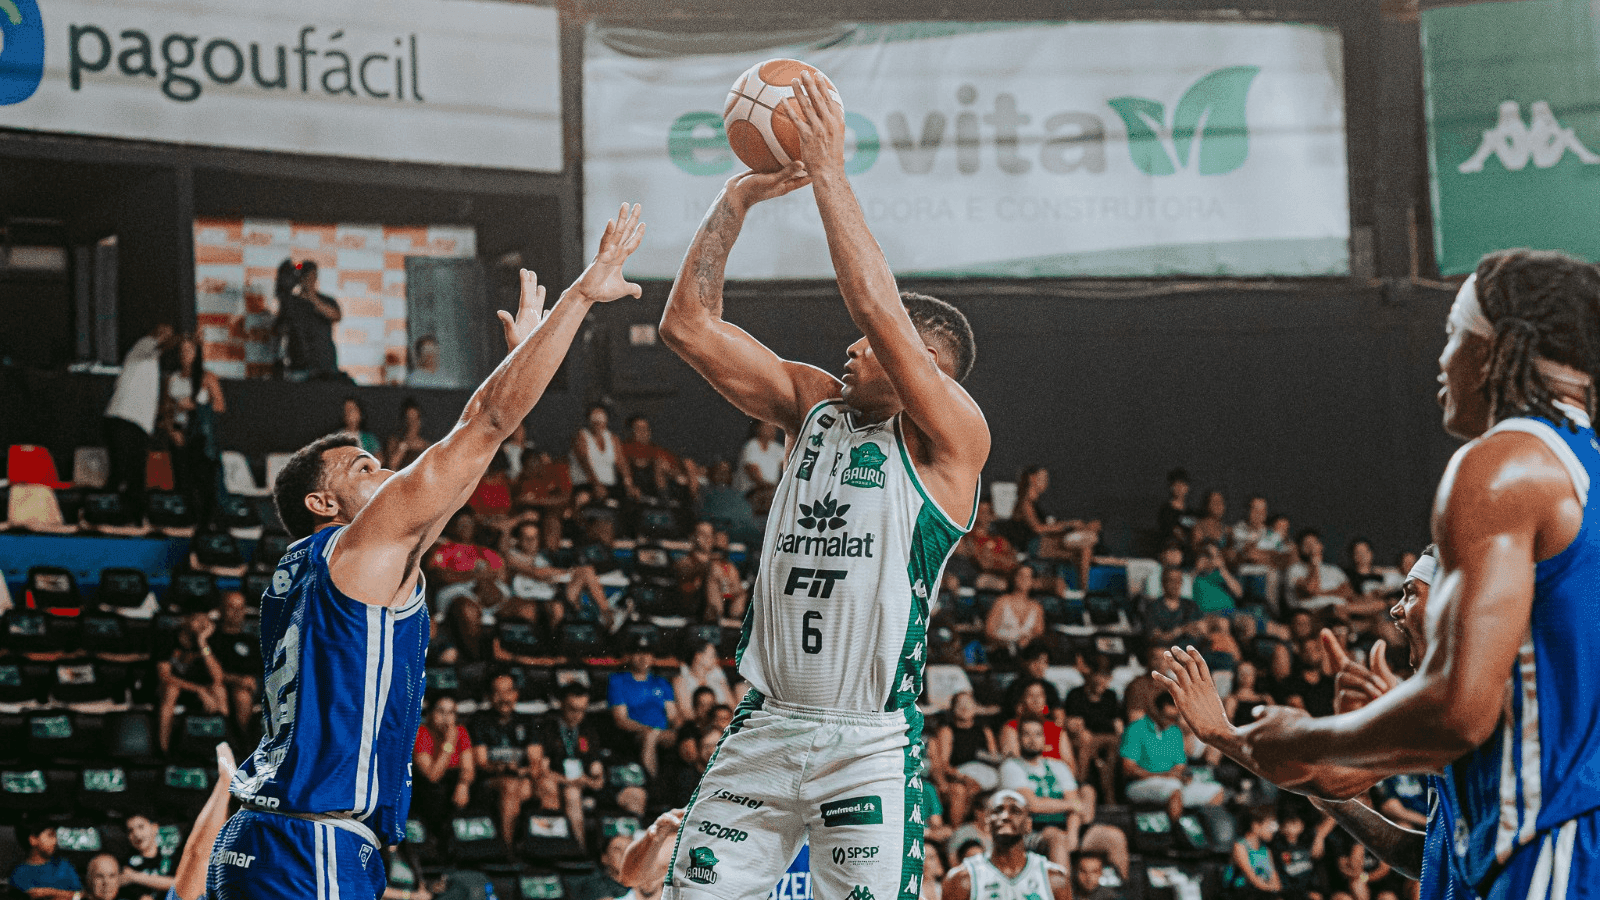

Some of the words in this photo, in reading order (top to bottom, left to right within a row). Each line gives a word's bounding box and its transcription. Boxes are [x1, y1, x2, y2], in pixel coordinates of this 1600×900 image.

[69, 26, 424, 101] pagoufácil
[668, 84, 1108, 178] eovita
[965, 197, 984, 222] E
[995, 197, 1226, 223] CONSTRUTORA
[842, 467, 885, 487] BAURU
[774, 532, 873, 558] parmalat
[802, 611, 823, 655] 6
[826, 804, 861, 816] Unimed
[698, 821, 748, 843] 3CORP
[847, 847, 879, 858] SPSP
[685, 867, 718, 883] BAURU
